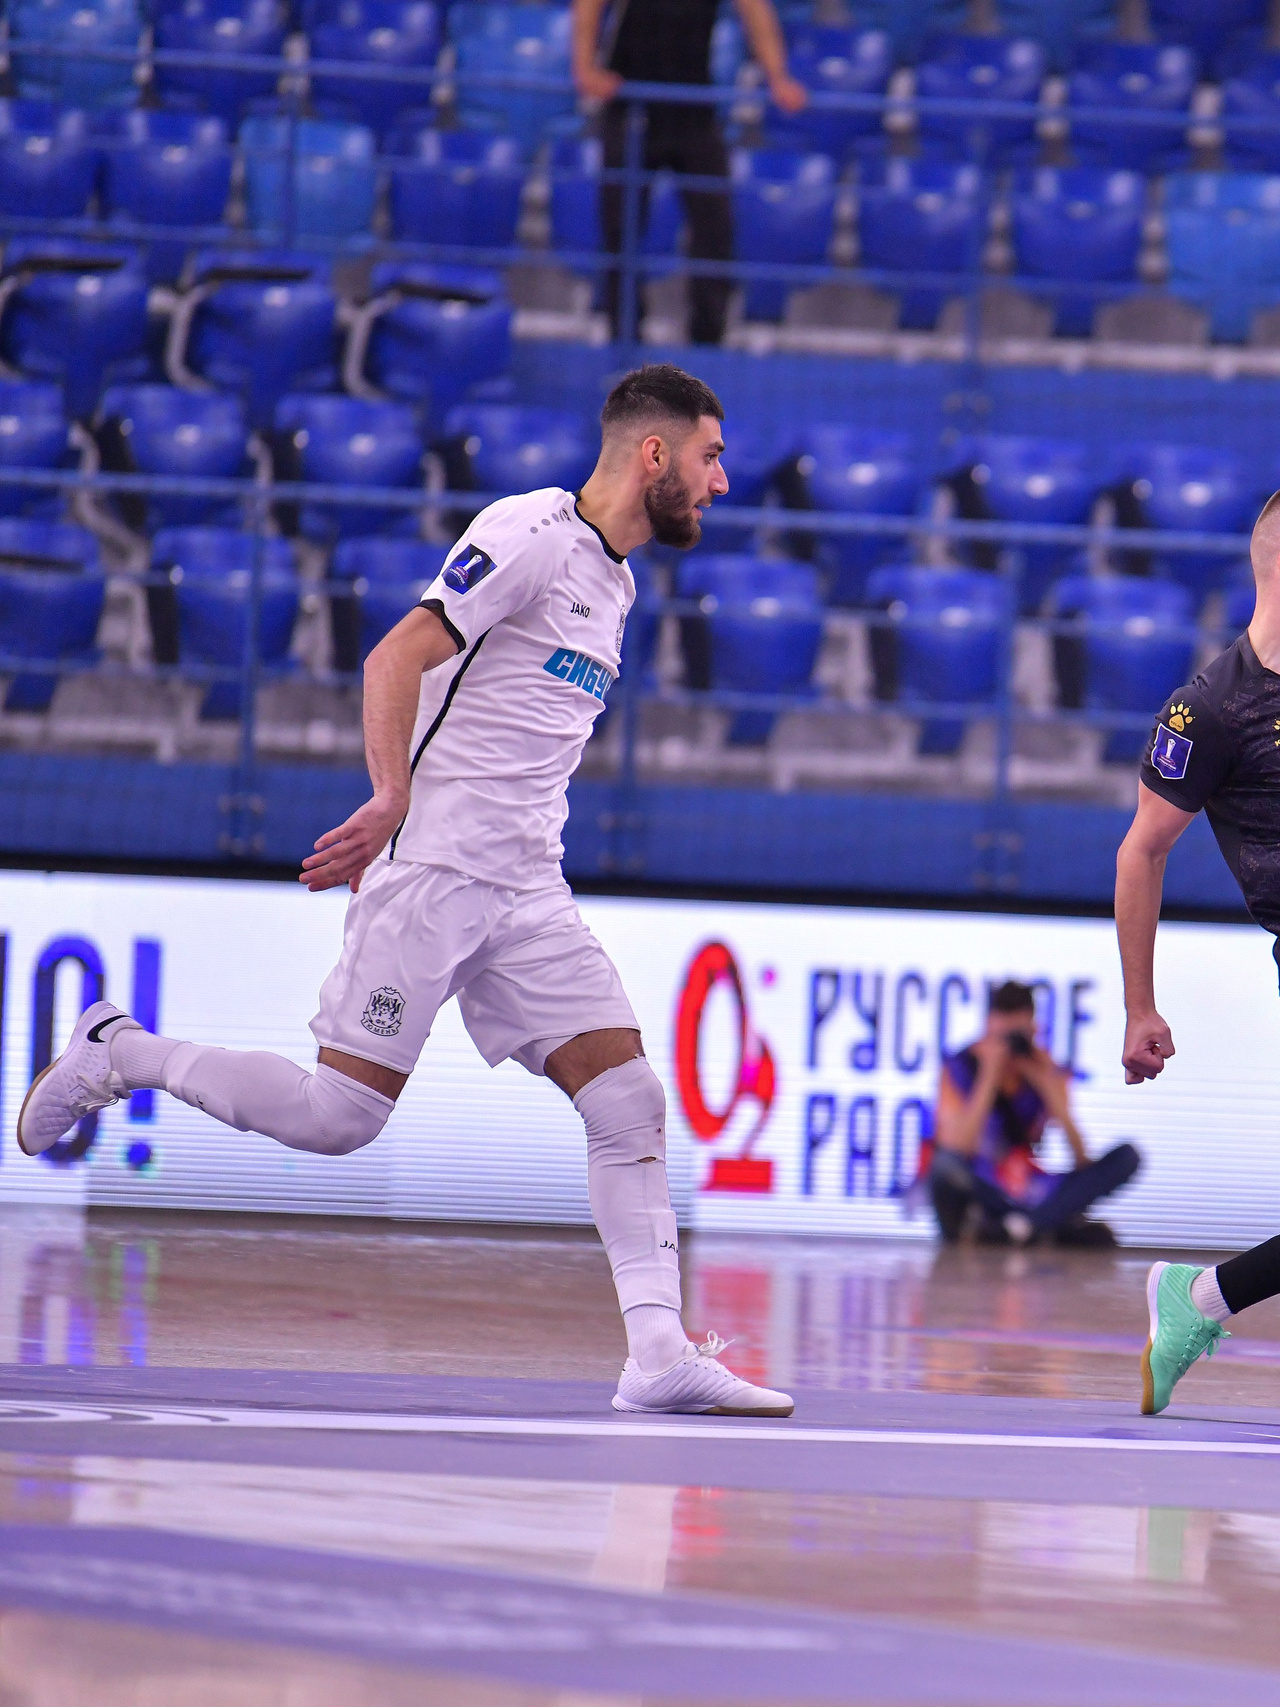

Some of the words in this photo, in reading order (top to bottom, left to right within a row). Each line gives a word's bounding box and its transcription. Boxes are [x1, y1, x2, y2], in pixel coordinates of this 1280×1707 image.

[570, 602, 590, 618] JAKO
[363, 1020, 397, 1035] ТЮМЕНЬ
[807, 968, 1096, 1082] РУССОЕ
